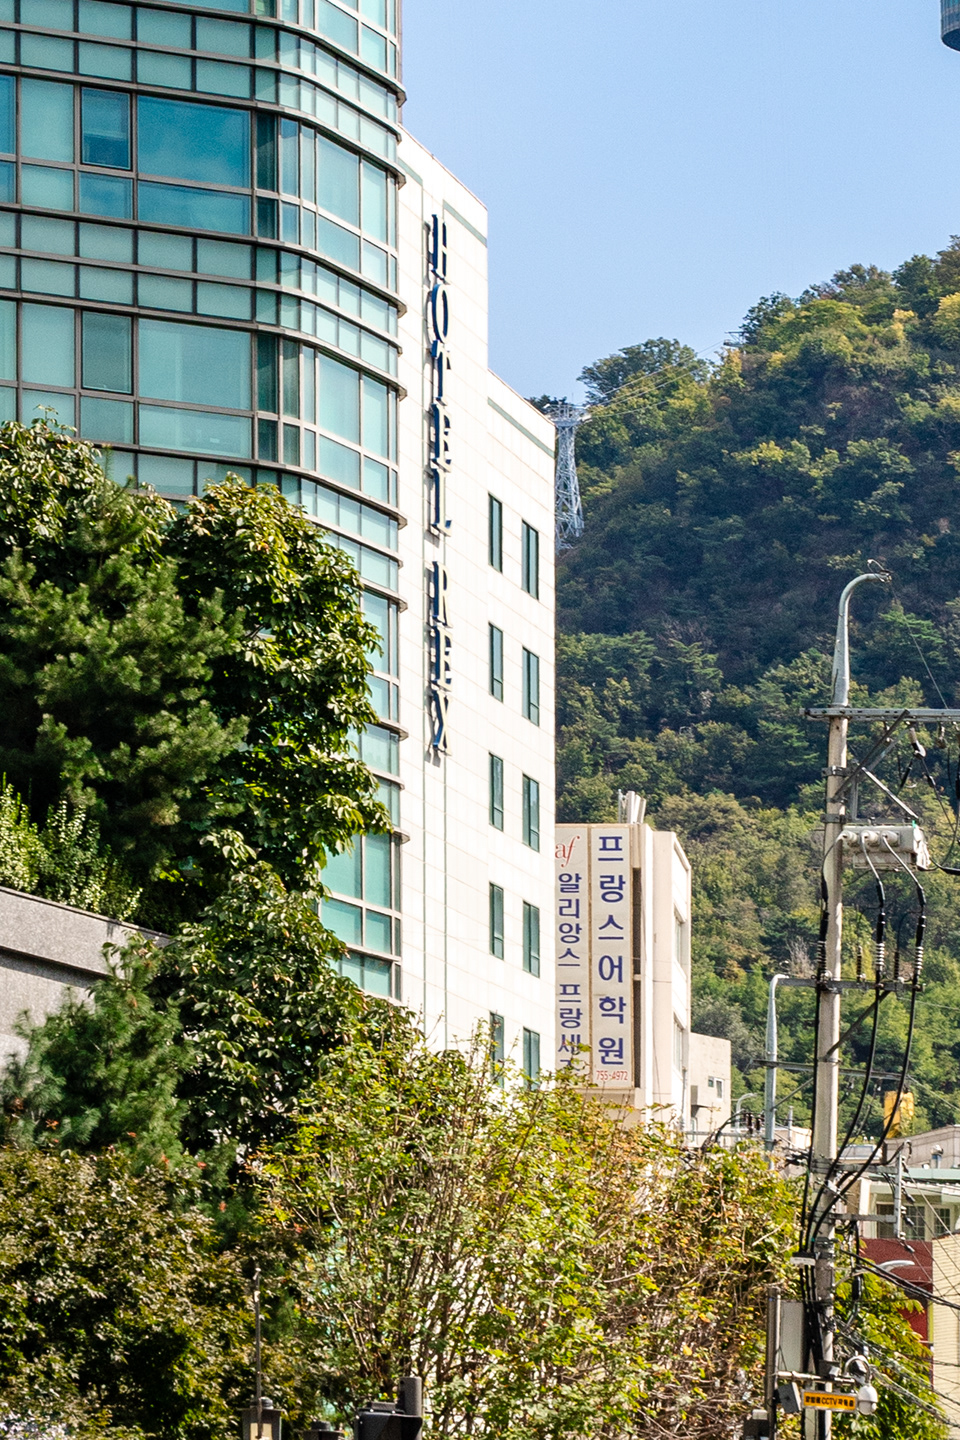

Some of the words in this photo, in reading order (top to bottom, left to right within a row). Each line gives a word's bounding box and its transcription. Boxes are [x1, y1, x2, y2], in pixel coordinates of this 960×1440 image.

[431, 214, 452, 537] HOTEL
[432, 561, 453, 756] REX
[558, 872, 582, 967] 알리앙스
[597, 836, 627, 1065] 프랑스어학원
[596, 1070, 628, 1081] 755-4972
